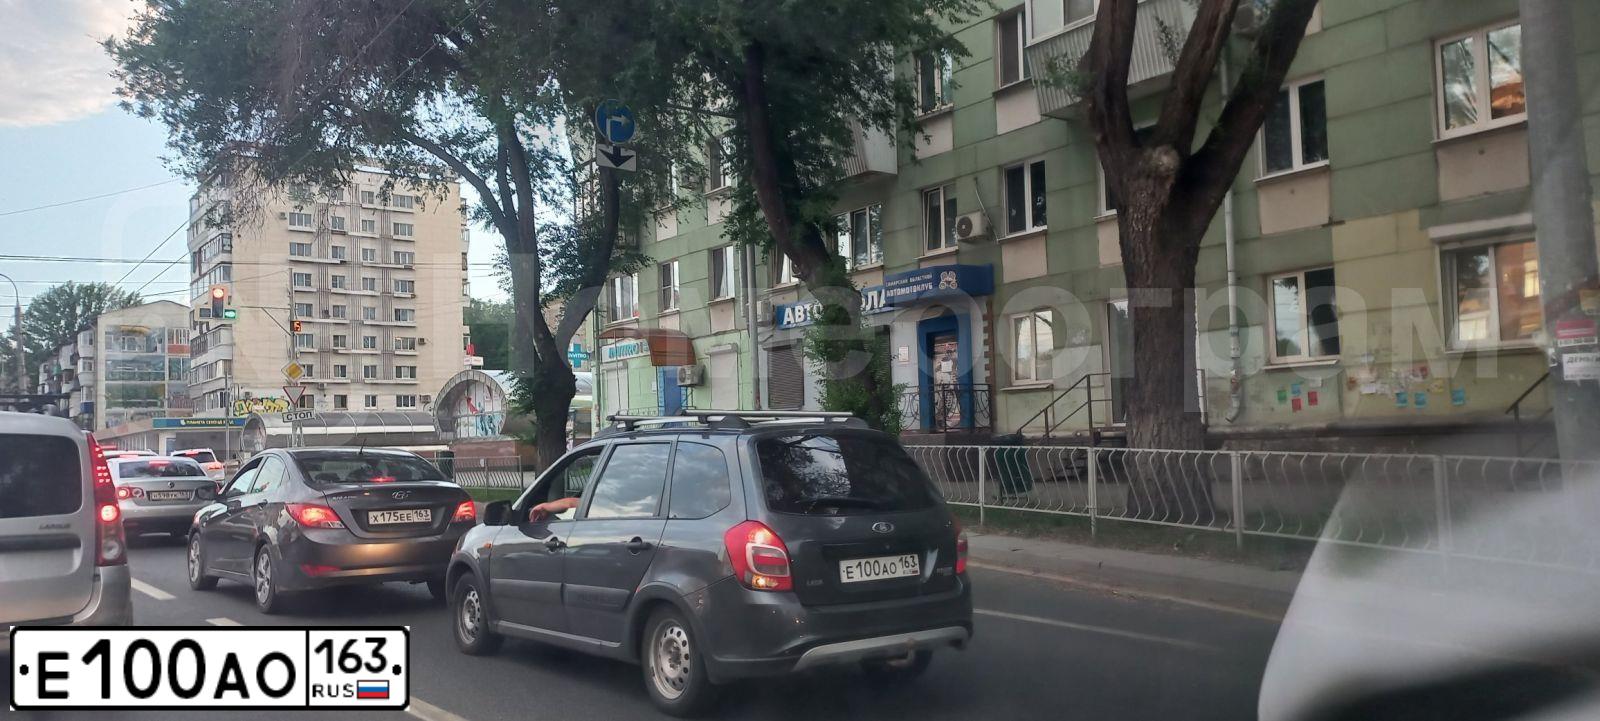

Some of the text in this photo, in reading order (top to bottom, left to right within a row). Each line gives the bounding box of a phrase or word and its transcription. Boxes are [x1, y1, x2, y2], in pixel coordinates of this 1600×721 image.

[886, 282, 933, 297] АВТОМОТОКЛУБ
[286, 411, 313, 421] СТОП
[373, 509, 429, 523] Х175ЕЕ 163
[846, 555, 915, 579] Е100АО 163
